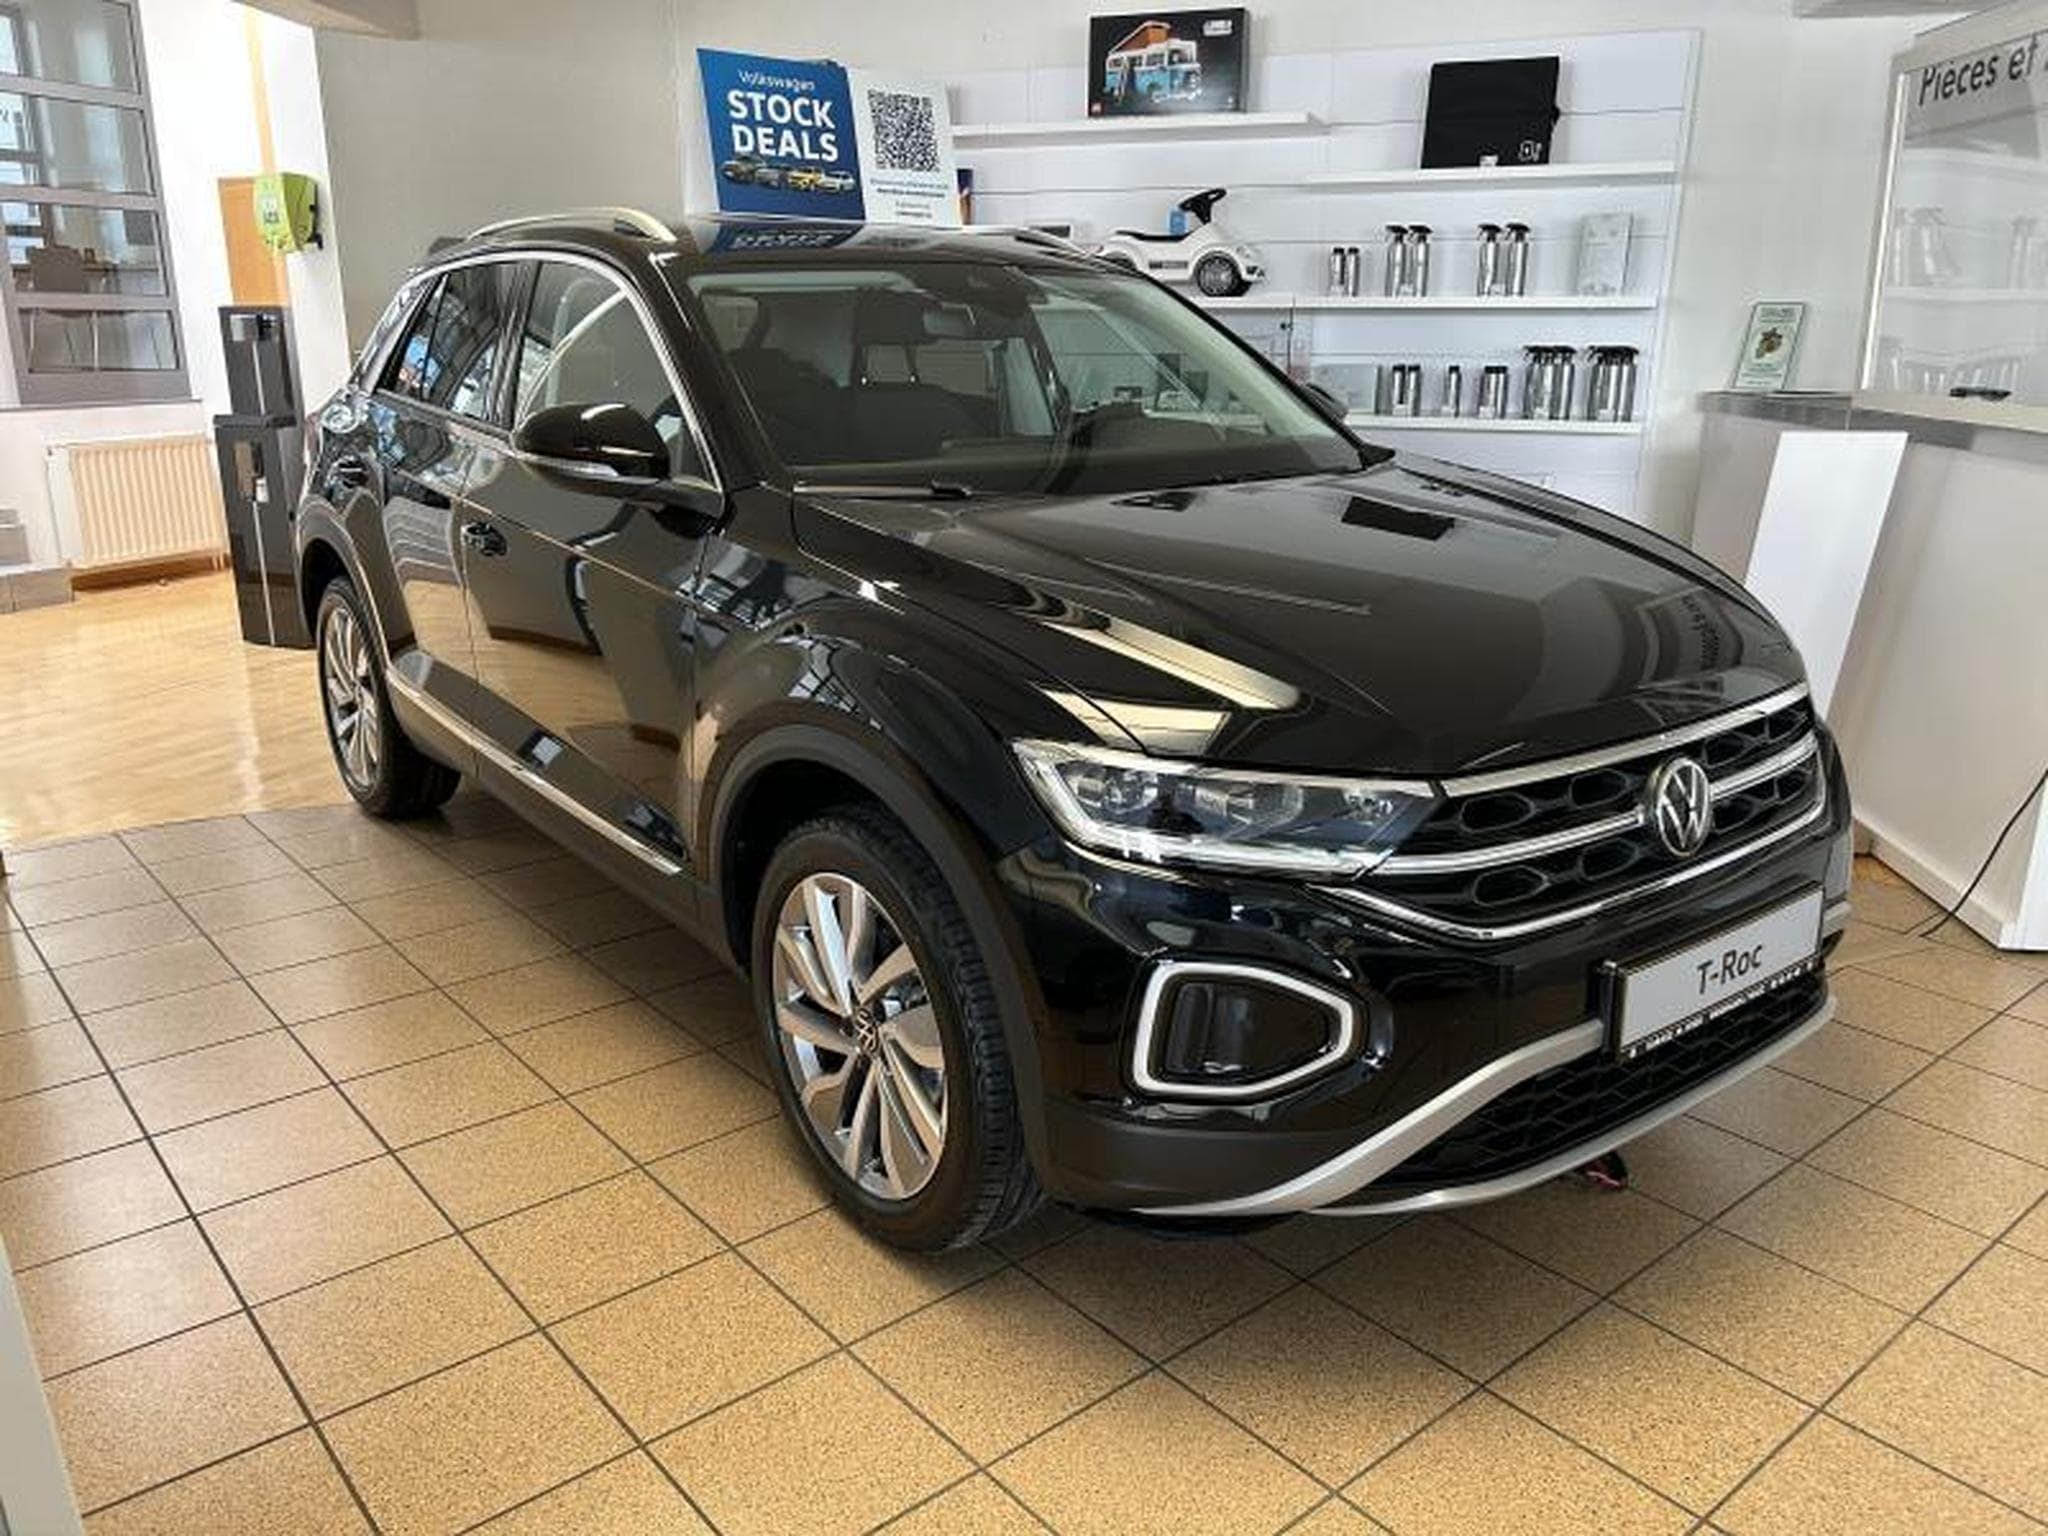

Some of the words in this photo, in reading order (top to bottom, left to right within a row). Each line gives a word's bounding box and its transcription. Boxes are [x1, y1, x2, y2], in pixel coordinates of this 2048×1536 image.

[2008, 33, 2038, 80] et
[738, 69, 816, 92] Volkswagen
[727, 90, 836, 129] STOCK
[731, 124, 840, 162] DEALS
[1696, 944, 1763, 996] T-Roc
